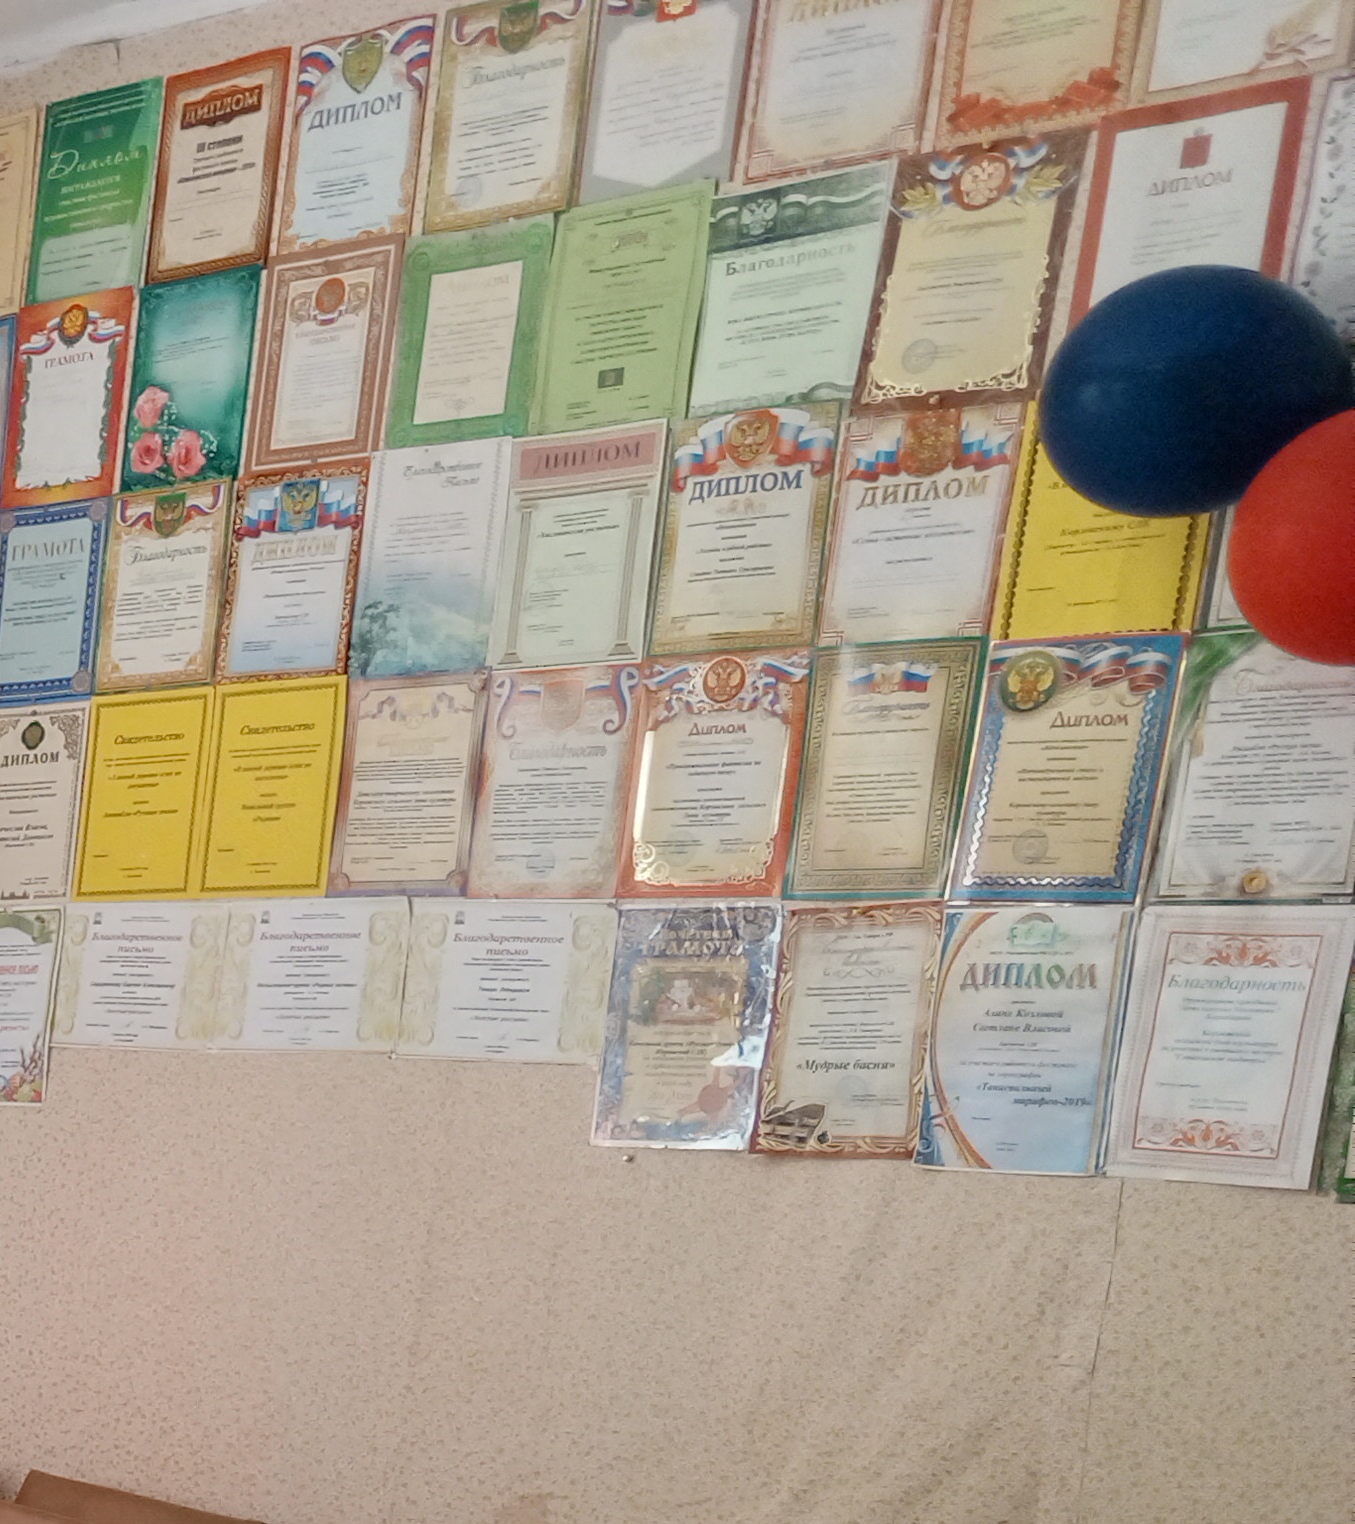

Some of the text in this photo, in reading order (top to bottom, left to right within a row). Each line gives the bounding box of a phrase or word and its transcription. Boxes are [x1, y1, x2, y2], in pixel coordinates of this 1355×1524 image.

[182, 87, 262, 126] ДИПЛОМ
[306, 91, 404, 133] ДИПЛОМ
[1146, 168, 1234, 198] ДИПЛОМ
[724, 243, 856, 277] Благодарность
[43, 350, 95, 369] ГРАМОТА
[688, 469, 806, 506] ДИПЛОМ
[855, 474, 991, 511] ДИПЛОМ
[11, 536, 85, 561] ГРАМОТА
[687, 721, 748, 738] Диплом
[1049, 710, 1130, 731] Диплом
[0, 750, 60, 768] ДИПЛОМ
[453, 932, 565, 946] Благодарственное
[485, 948, 530, 956] письмо
[959, 962, 1098, 992] ДИПЛОМ
[1167, 972, 1308, 994] Благодарность
[796, 1059, 896, 1074] «Мудрые басни»
